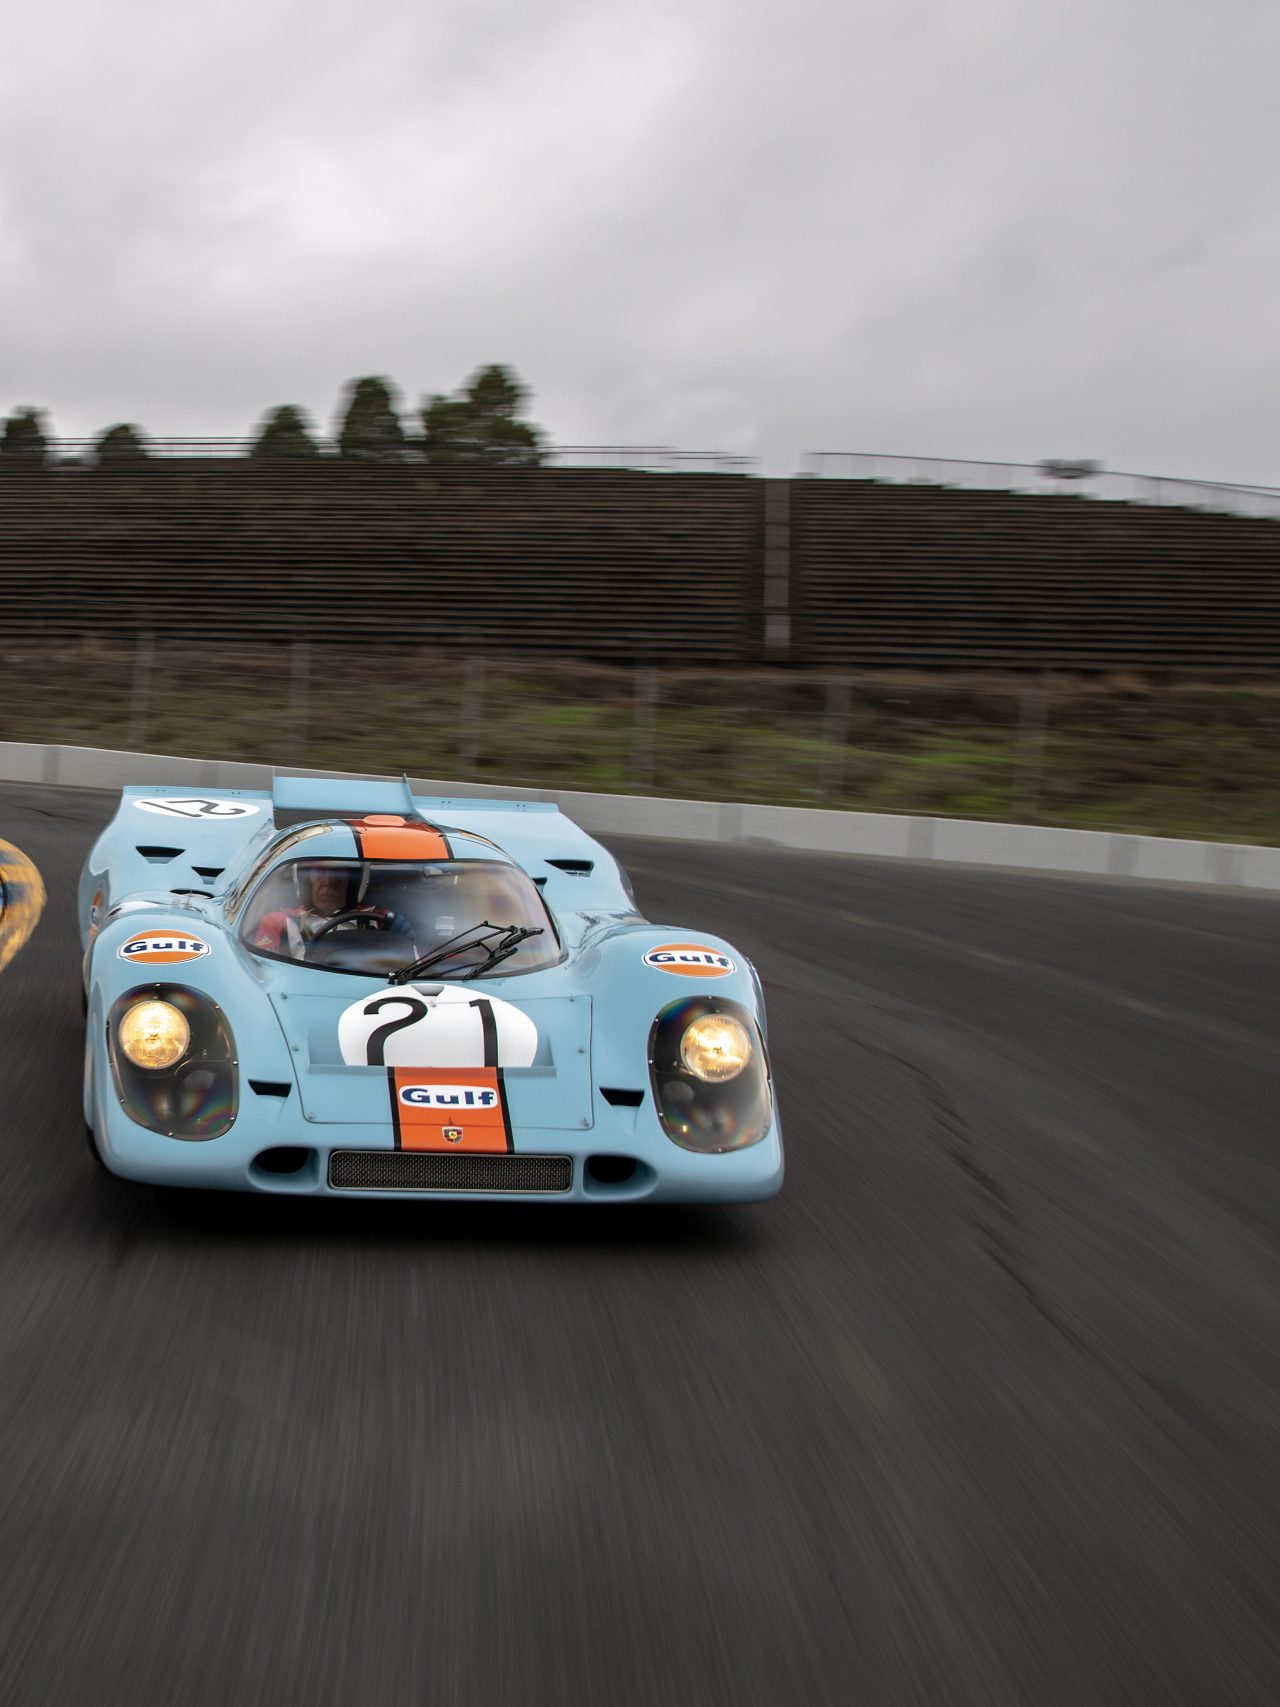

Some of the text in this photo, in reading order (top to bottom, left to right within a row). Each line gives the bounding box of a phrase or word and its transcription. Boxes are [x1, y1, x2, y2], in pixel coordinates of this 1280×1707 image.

[123, 940, 205, 954] Gulf
[649, 952, 730, 968] Gulf
[363, 996, 499, 1068] 21
[401, 1088, 495, 1105] Gulf
